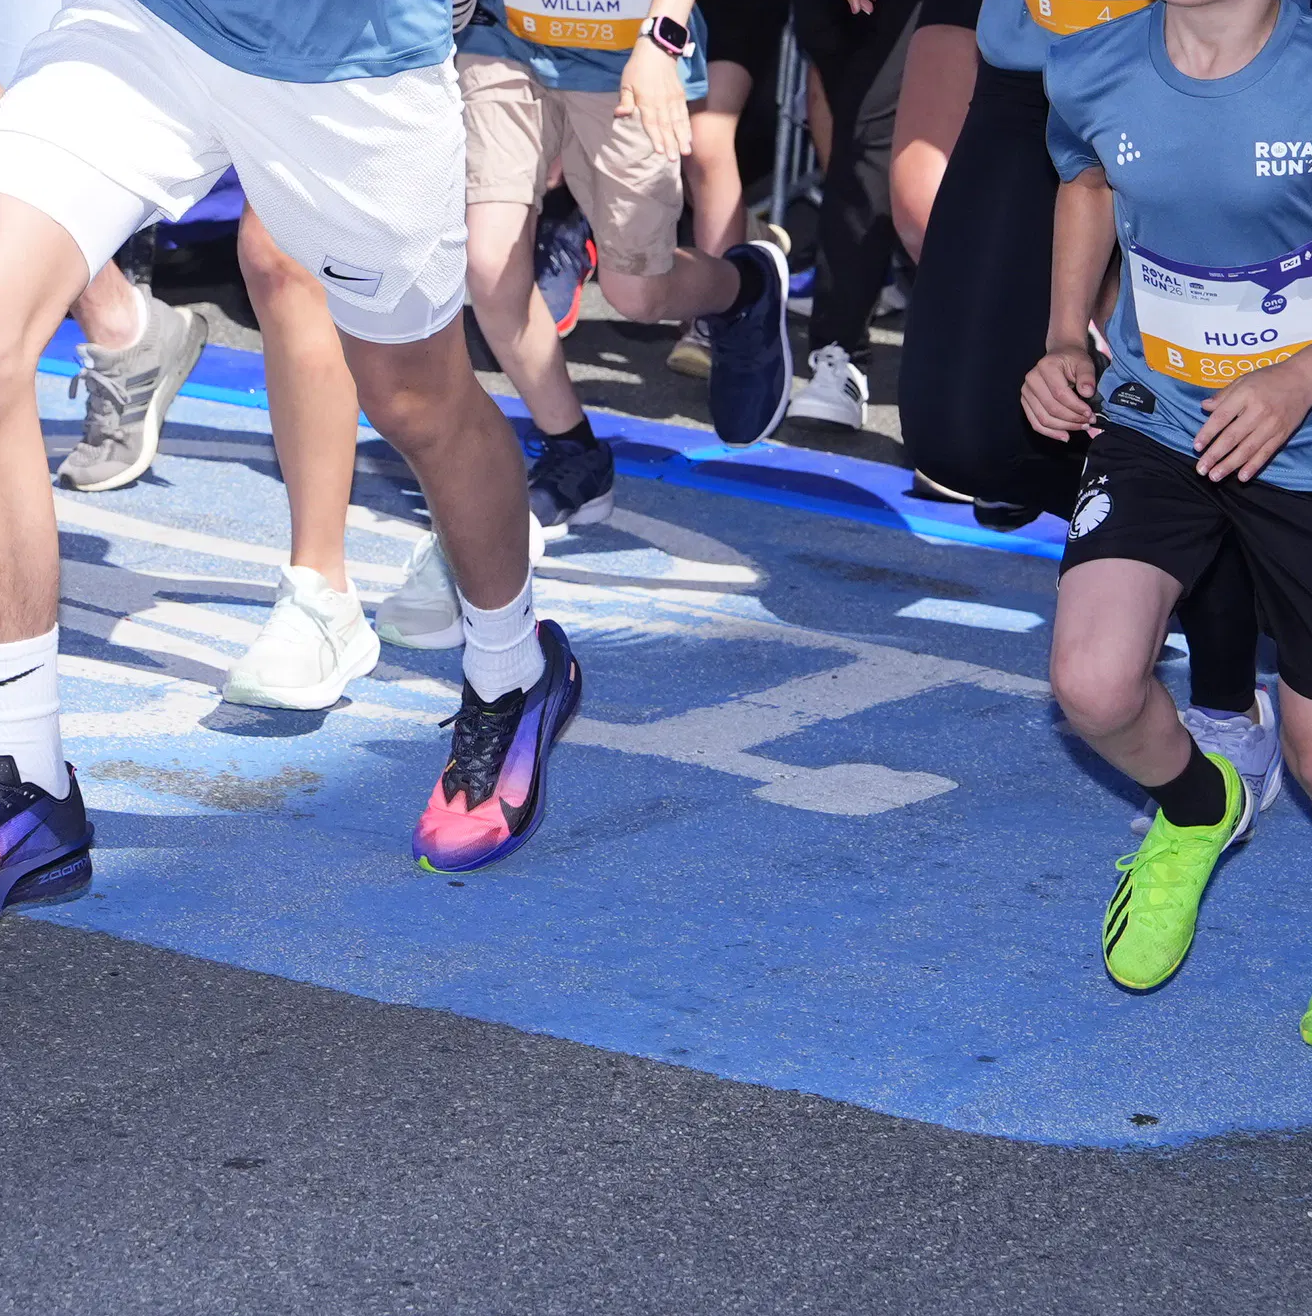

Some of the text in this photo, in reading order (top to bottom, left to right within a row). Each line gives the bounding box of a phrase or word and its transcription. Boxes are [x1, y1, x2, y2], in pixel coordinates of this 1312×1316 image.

[1096, 6, 1114, 22] 4
[522, 16, 537, 33] B
[549, 20, 615, 41] 87578
[1141, 263, 1182, 287] ROYAL
[1264, 297, 1285, 309] one
[1204, 328, 1279, 347] HUGO
[1166, 347, 1185, 368] B
